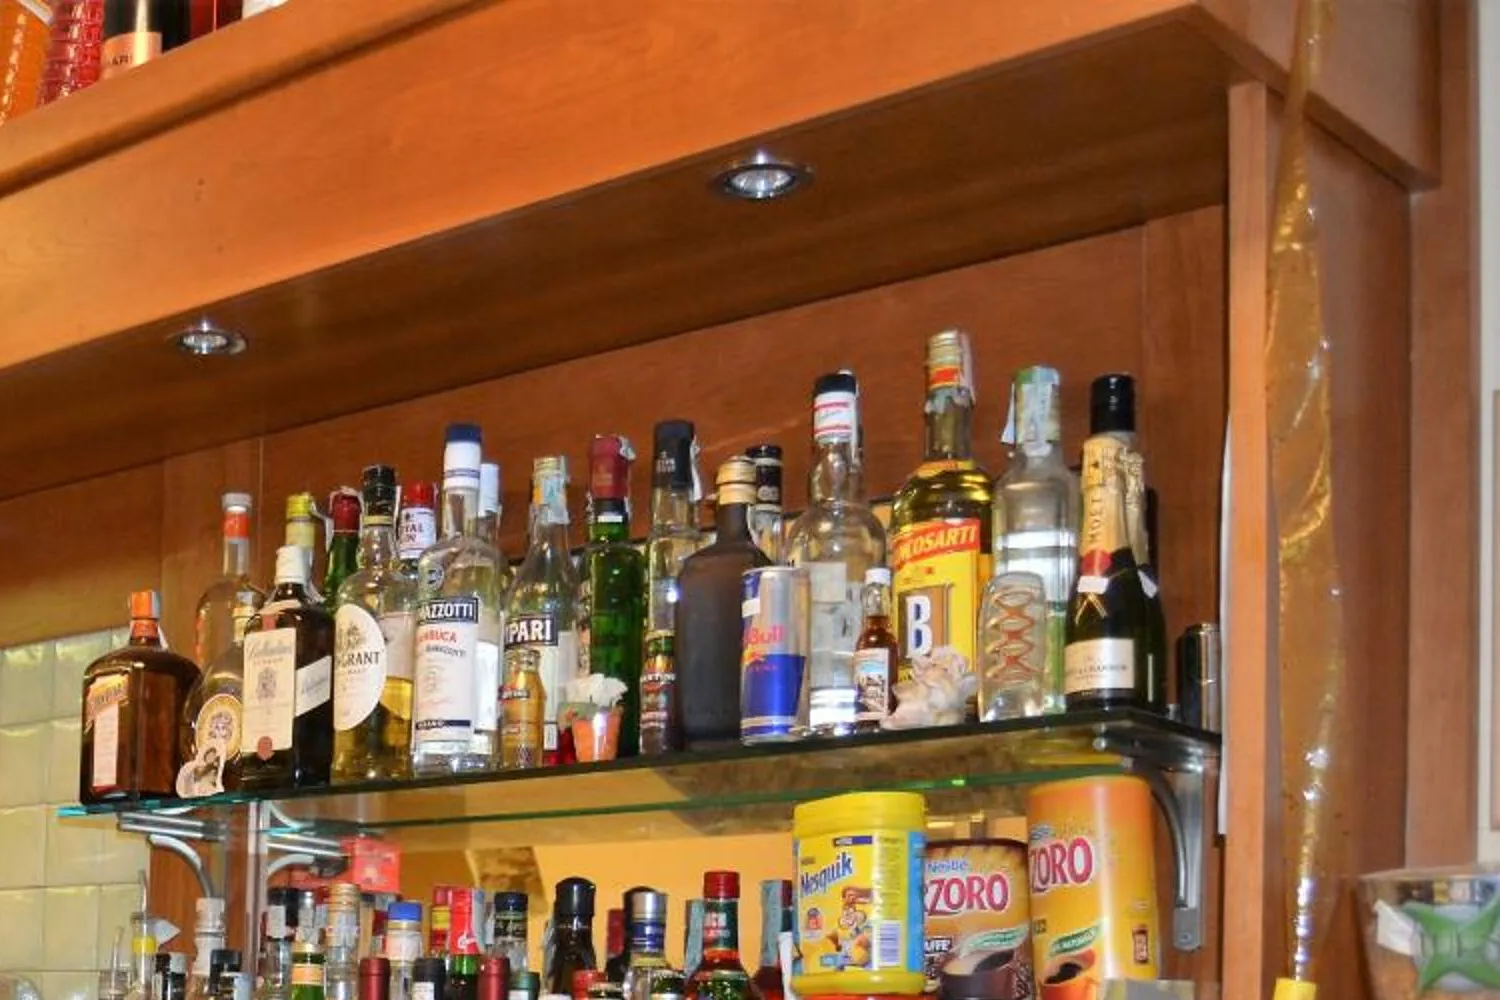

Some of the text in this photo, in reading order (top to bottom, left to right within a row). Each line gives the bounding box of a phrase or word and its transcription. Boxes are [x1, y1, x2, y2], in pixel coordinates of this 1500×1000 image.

[421, 602, 474, 620] AZZOTTI
[506, 617, 553, 643] PARI
[800, 851, 852, 897] Nesquik
[1029, 836, 1093, 893] ZORO
[925, 873, 1009, 917] ZORO
